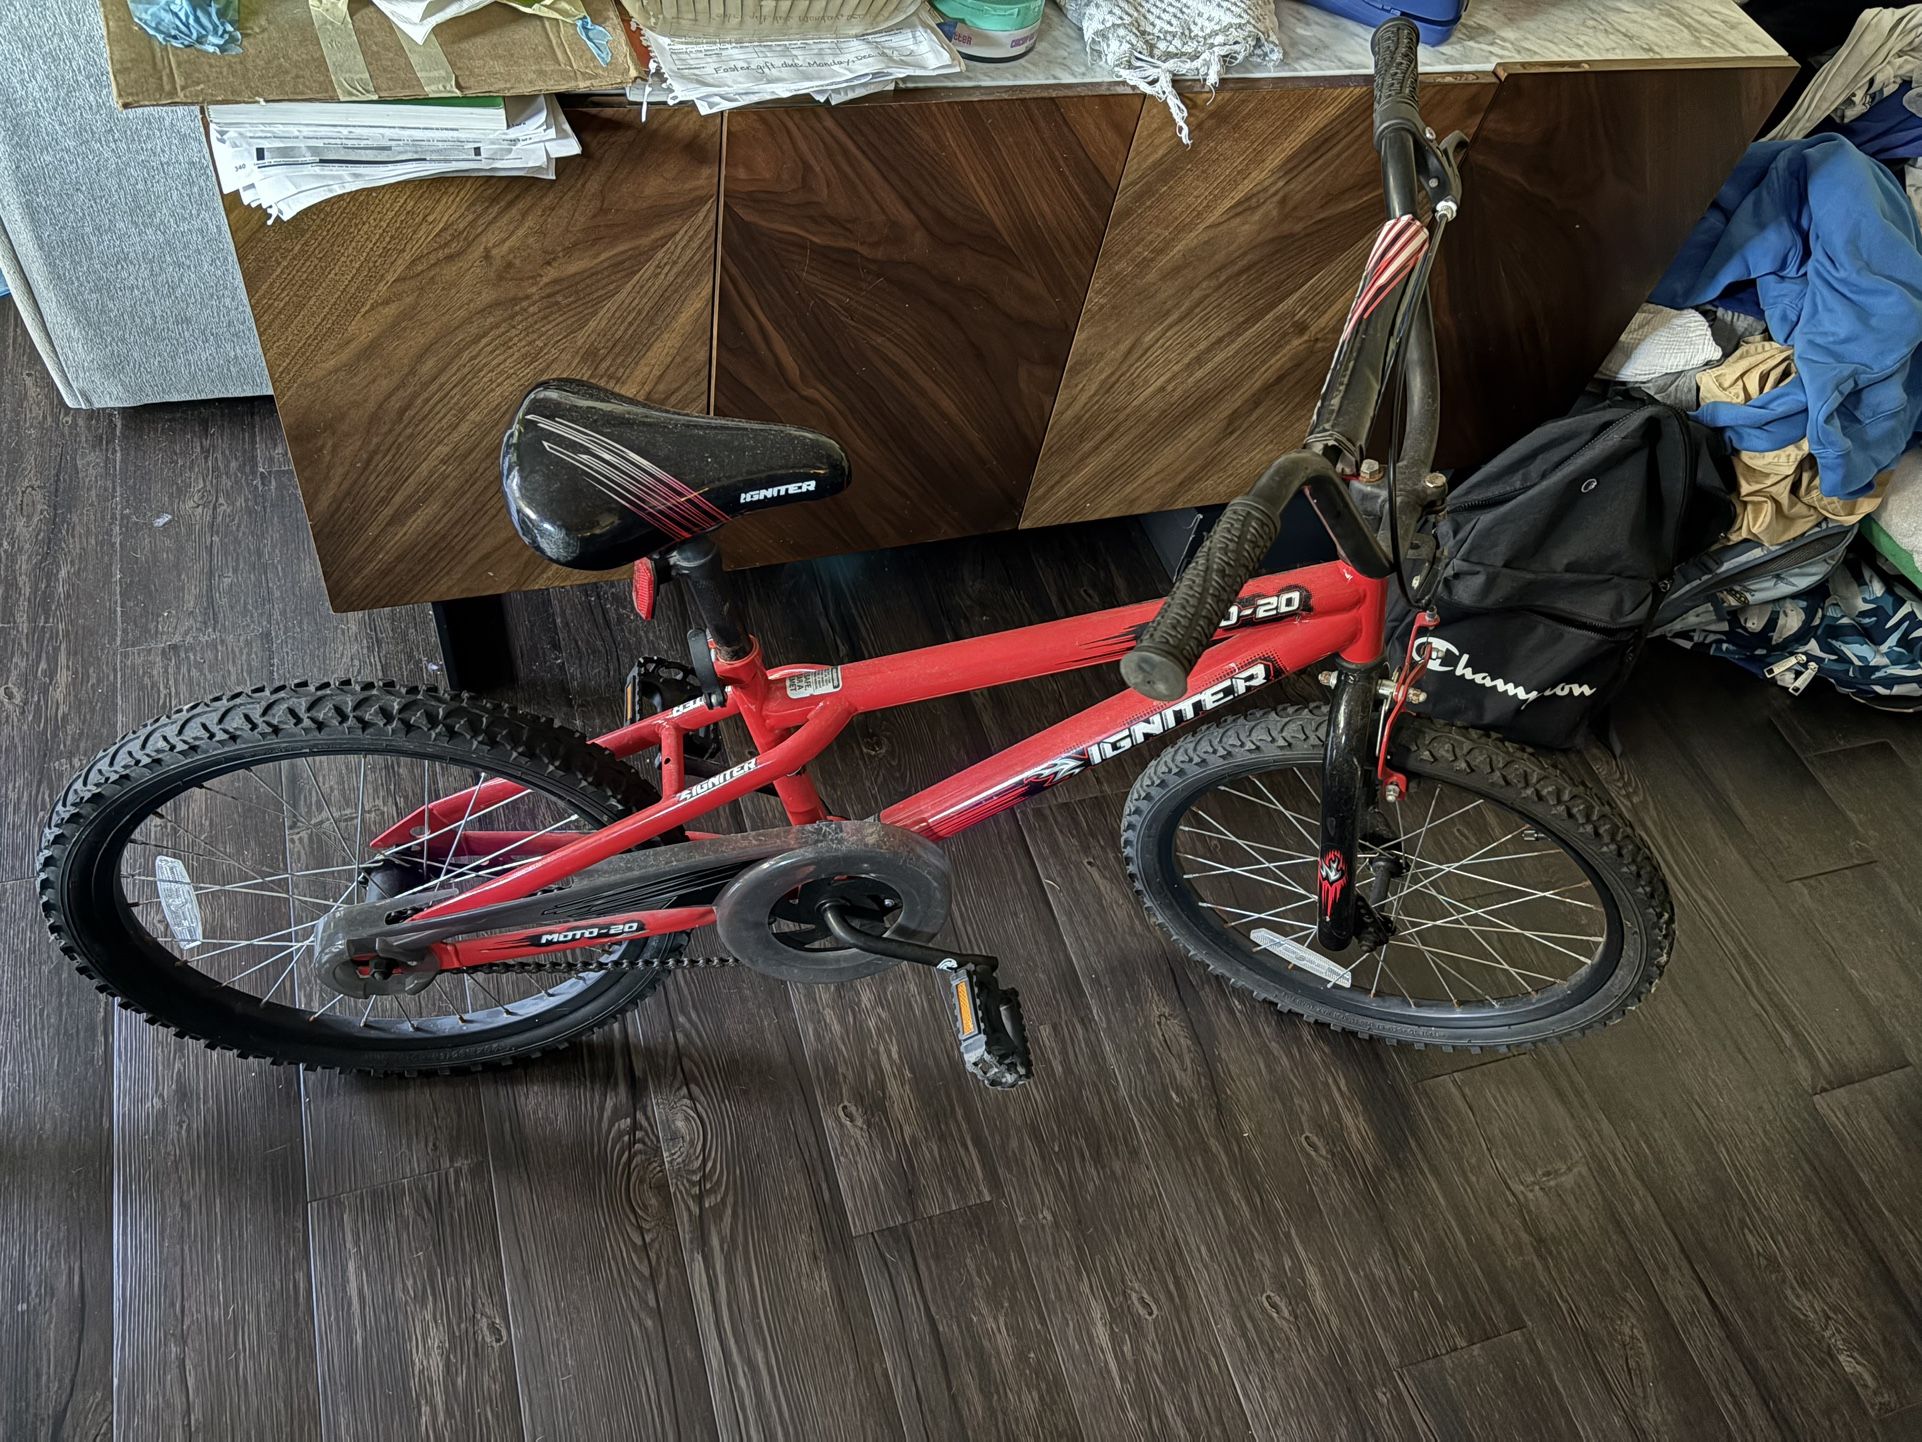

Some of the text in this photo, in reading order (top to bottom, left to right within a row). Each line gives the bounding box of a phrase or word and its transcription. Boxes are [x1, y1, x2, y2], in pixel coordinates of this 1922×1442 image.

[740, 480, 817, 503] IGNITER
[1087, 663, 1268, 765] IGNITER
[691, 758, 757, 797] IGNITER
[540, 922, 639, 944] MOTO-20
